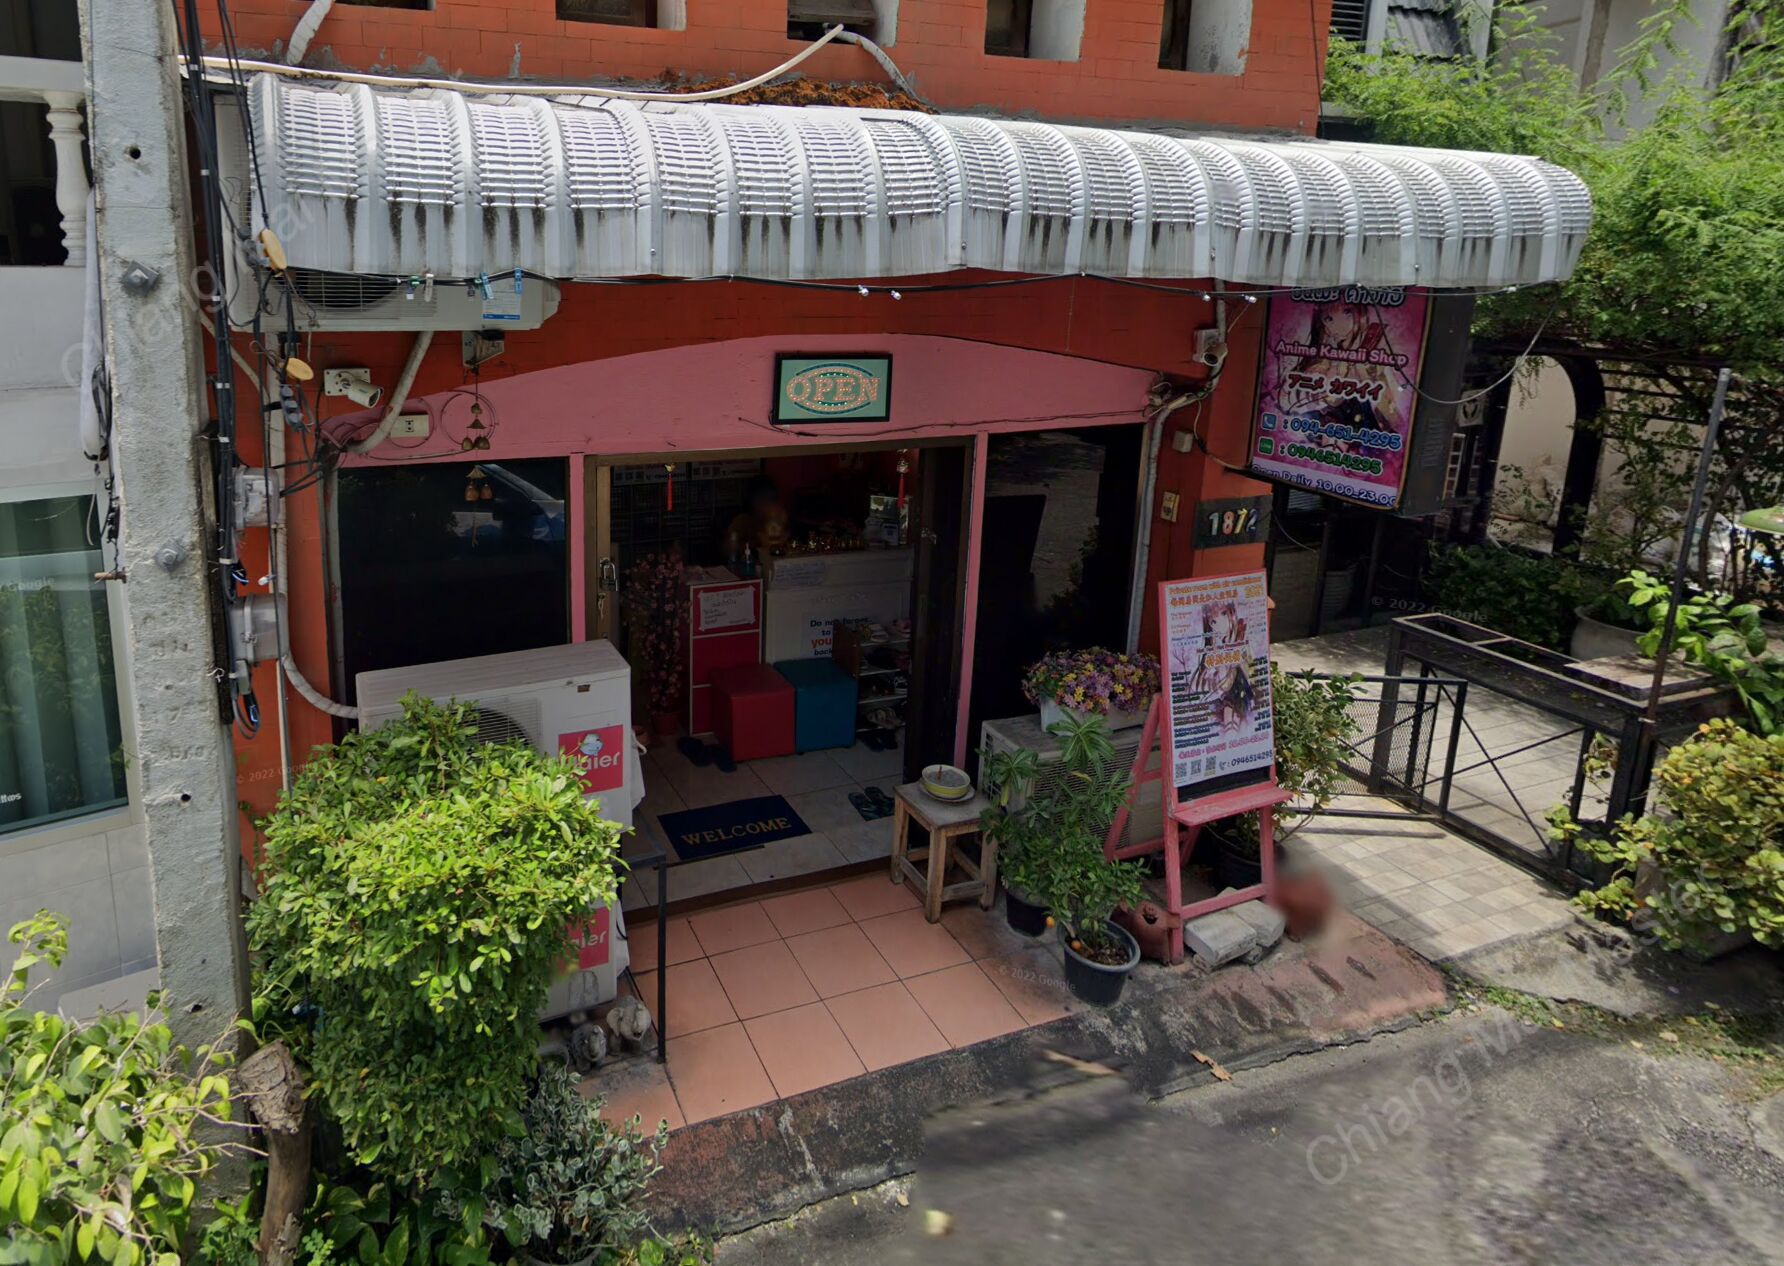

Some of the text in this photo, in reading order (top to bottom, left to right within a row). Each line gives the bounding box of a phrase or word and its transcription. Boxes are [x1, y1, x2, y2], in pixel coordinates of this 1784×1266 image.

[1276, 341, 1408, 367] Anime Kawaii Shop
[786, 376, 880, 402] OPEN
[1288, 374, 1384, 401] アニメ カワイイ
[1287, 443, 1382, 475] 0946514295
[1282, 470, 1313, 488] Daily
[1209, 507, 1257, 536] 1872
[680, 816, 792, 846] WELCOME
